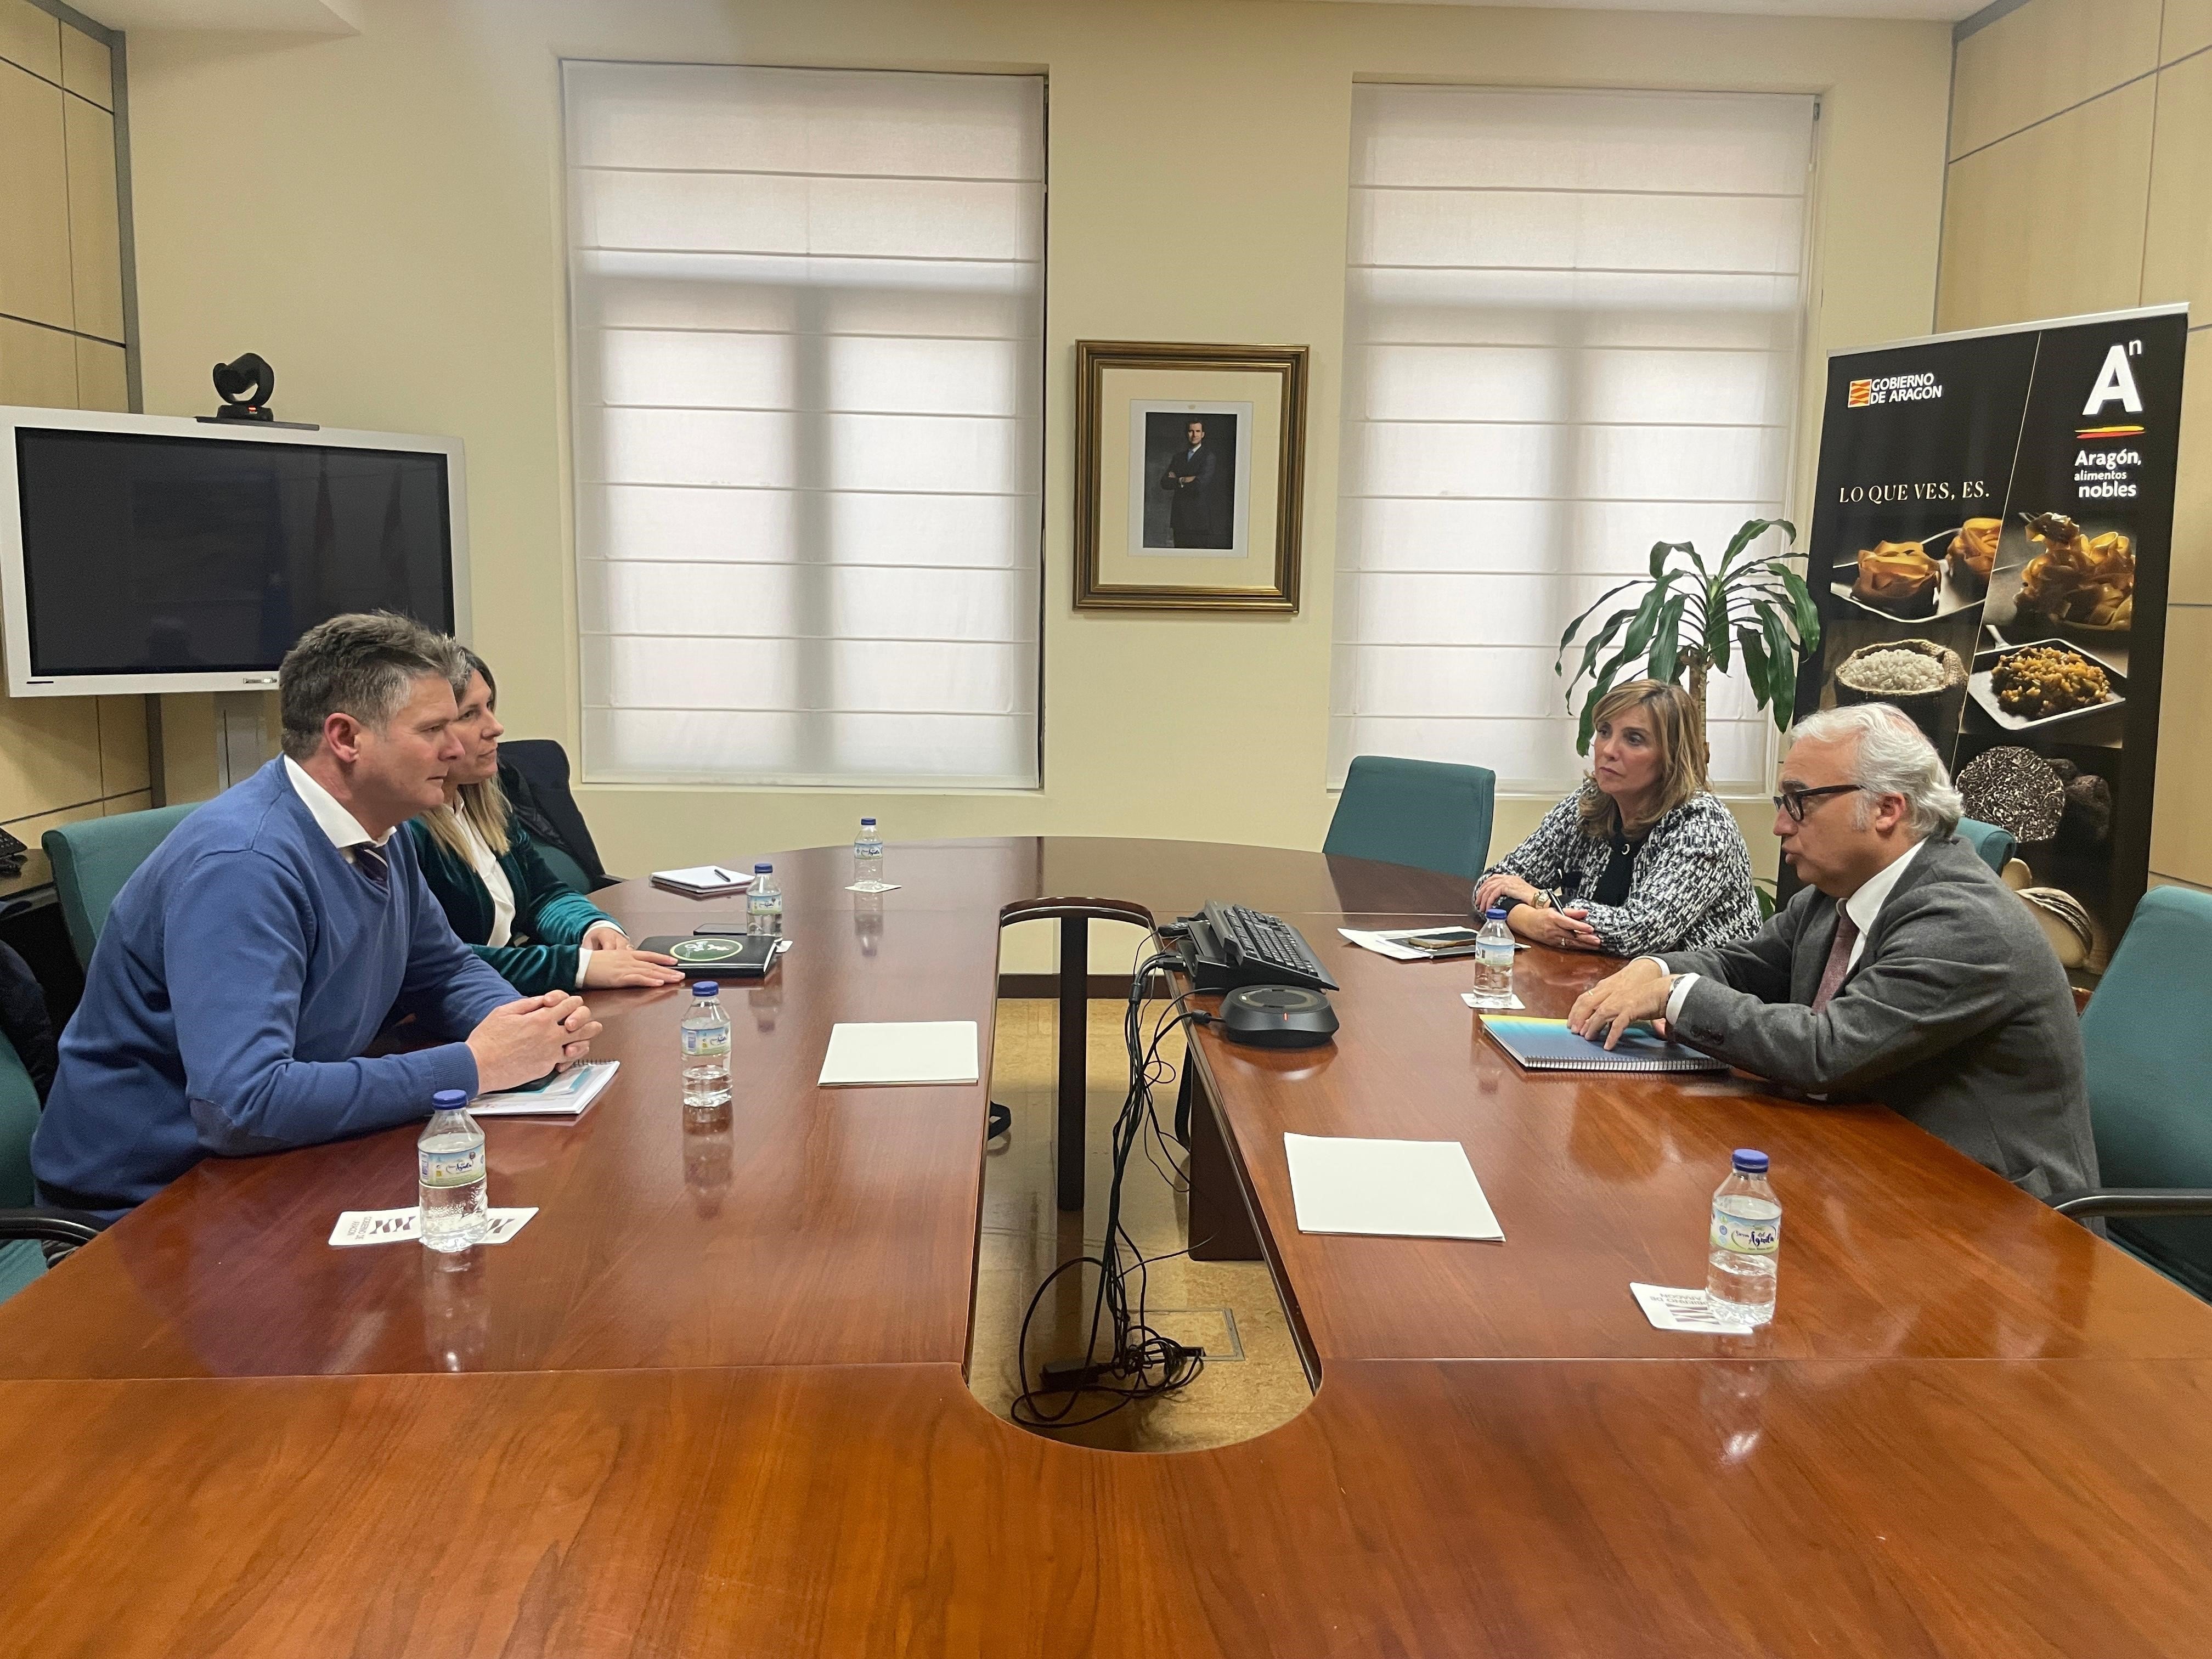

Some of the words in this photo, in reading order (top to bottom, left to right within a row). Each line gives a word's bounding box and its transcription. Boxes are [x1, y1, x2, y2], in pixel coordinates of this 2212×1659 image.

[1871, 373, 1934, 391] GOBIERNO
[1870, 391, 1886, 405] DE
[1888, 385, 1943, 403] ARAGON
[2074, 448, 2142, 470] Aragón,
[2074, 470, 2128, 481] alimentos
[1839, 486, 1864, 503] LO
[1868, 484, 1909, 505] QUE
[1914, 482, 1955, 501] VES,
[1962, 481, 1990, 499] ES.
[2078, 481, 2137, 498] nobles
